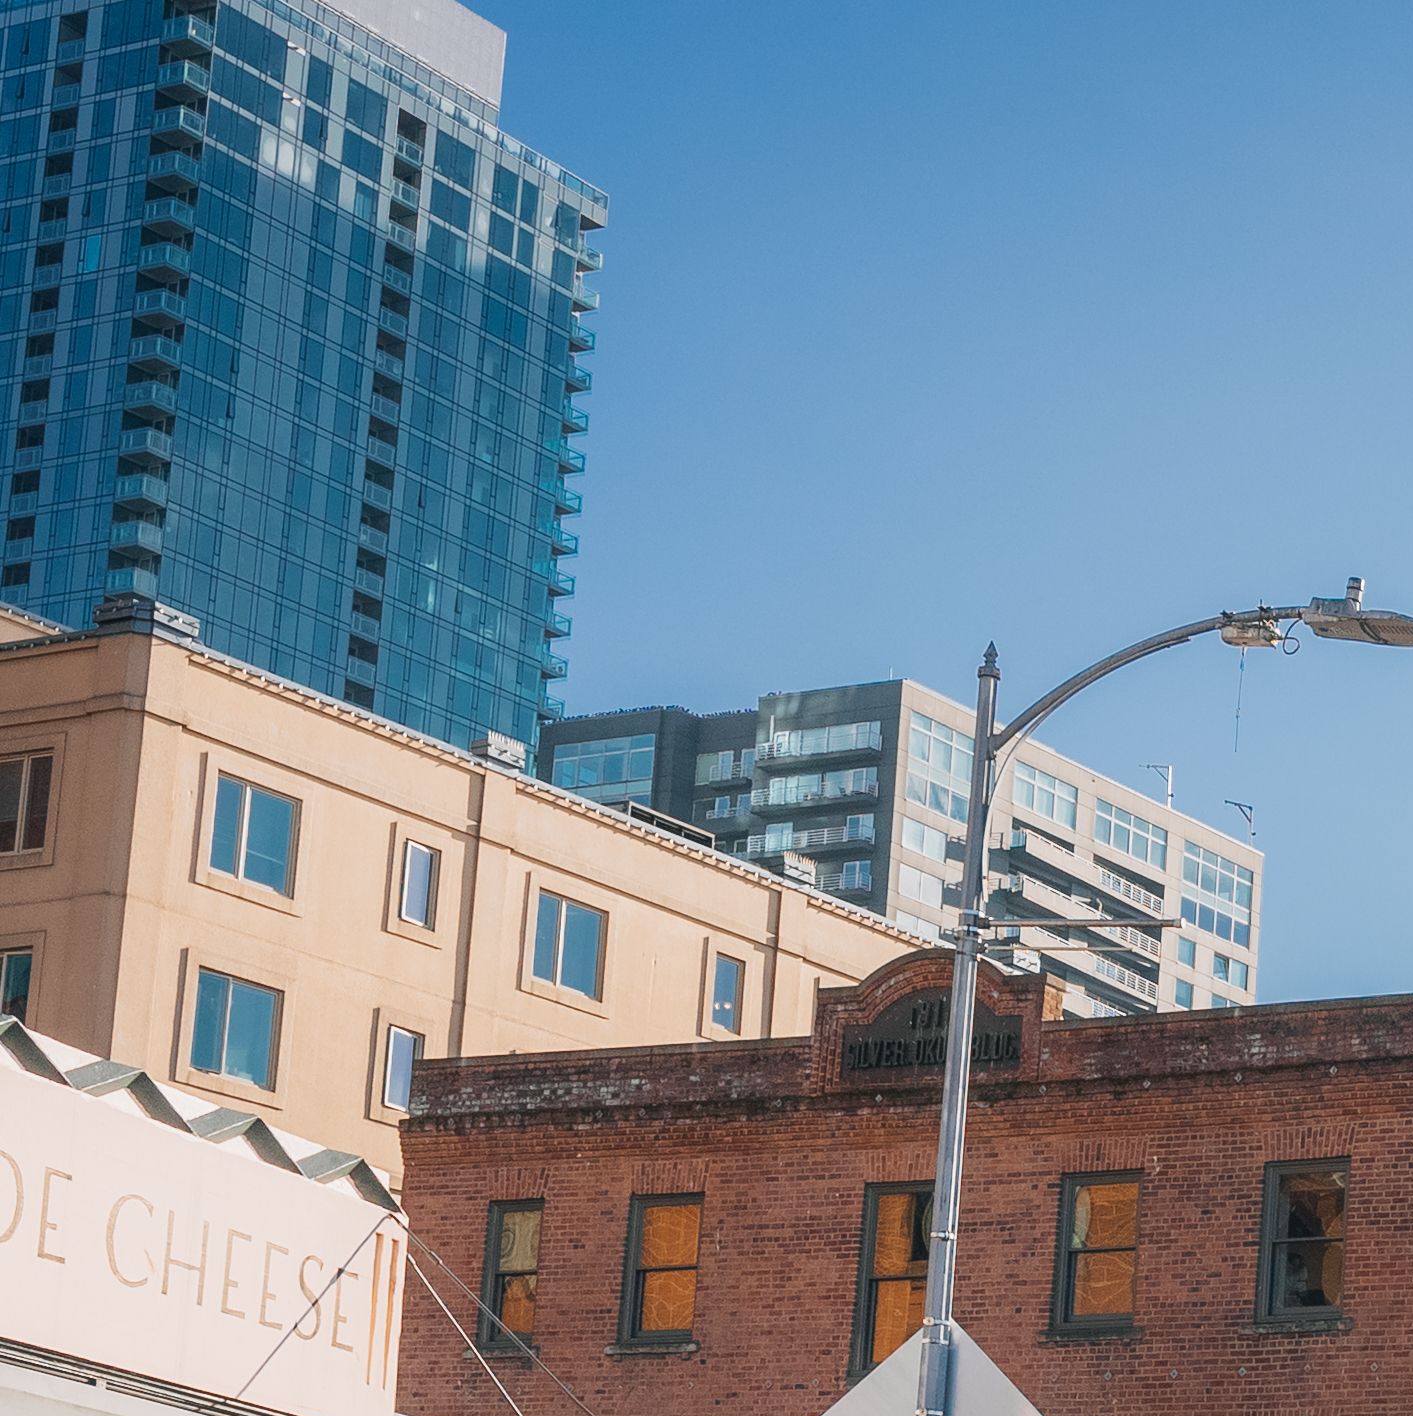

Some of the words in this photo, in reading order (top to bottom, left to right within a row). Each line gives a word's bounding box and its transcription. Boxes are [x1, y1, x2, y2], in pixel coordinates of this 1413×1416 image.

[911, 998, 949, 1030] 191
[847, 1037, 905, 1069] SILVER
[914, 1034, 948, 1065] OKU
[105, 1193, 359, 1353] CHEESE
